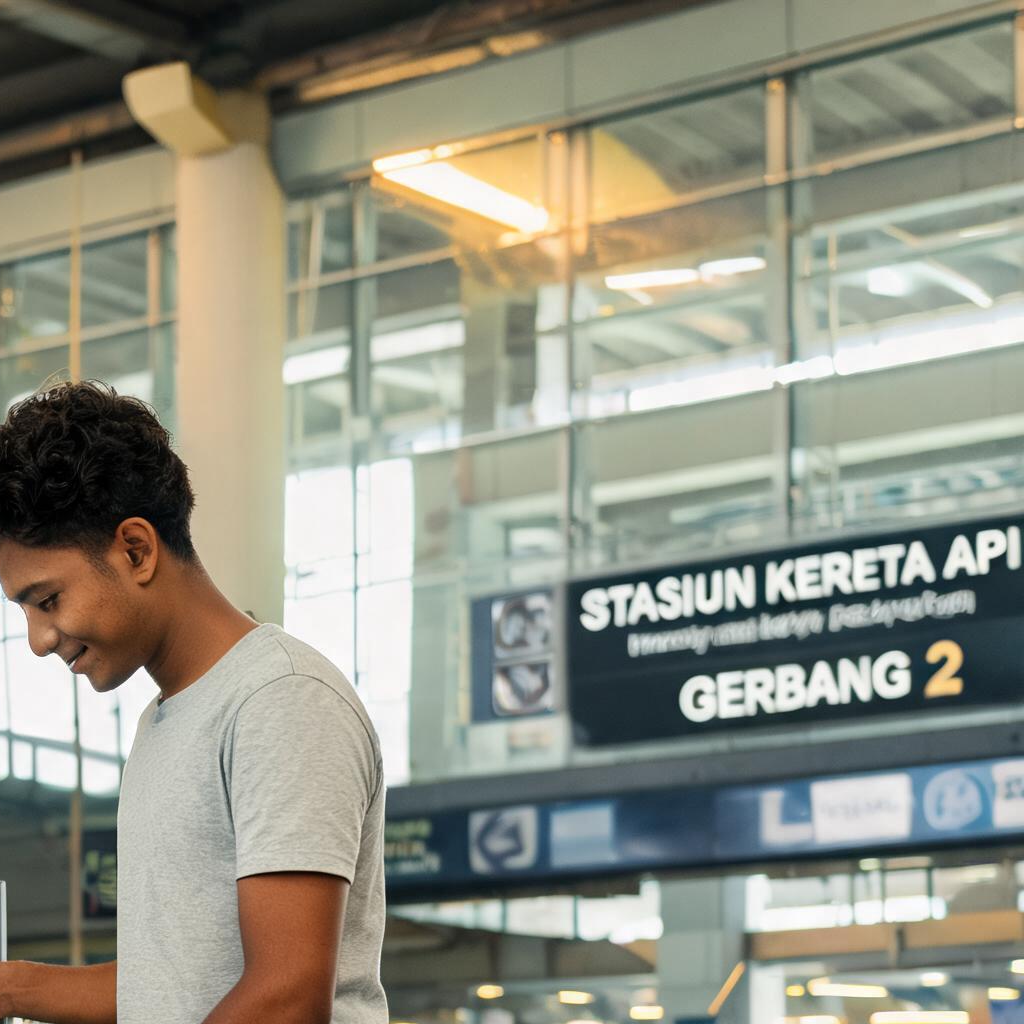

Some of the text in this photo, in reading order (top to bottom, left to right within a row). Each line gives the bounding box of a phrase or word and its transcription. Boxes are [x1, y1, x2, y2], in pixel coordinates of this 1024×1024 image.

[579, 564, 756, 632] STASIUN
[764, 540, 937, 605] KERETA
[942, 525, 1022, 580] API
[678, 639, 965, 723] GERBANG 2
